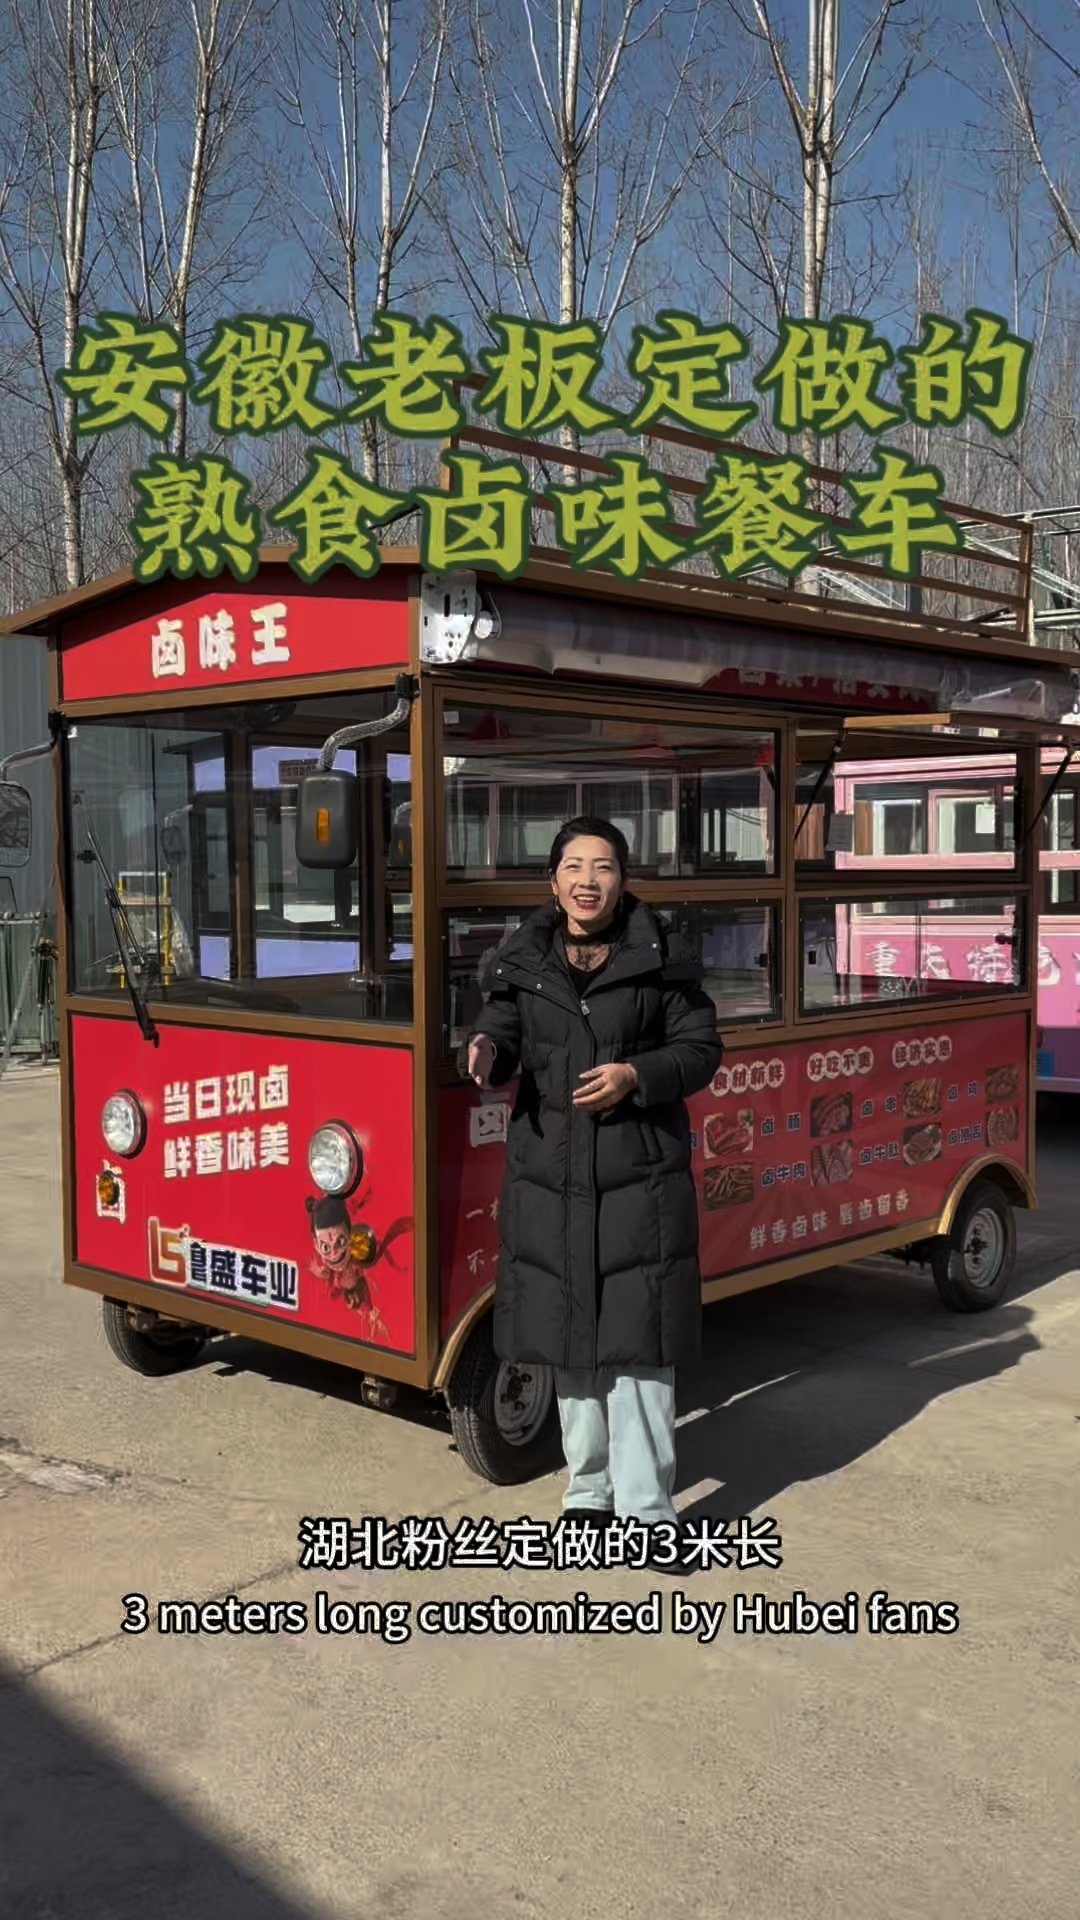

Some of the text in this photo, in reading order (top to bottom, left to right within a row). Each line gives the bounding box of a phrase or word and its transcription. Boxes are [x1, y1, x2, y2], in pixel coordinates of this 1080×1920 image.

[151, 602, 291, 678] 卤味王
[163, 1064, 289, 1124] 当日现卤
[163, 1122, 290, 1179] 鲜香味美
[760, 1160, 806, 1188] 卤牛肉
[750, 1208, 828, 1250] 鲜香卤味
[190, 1240, 298, 1307] 鲁盛车业
